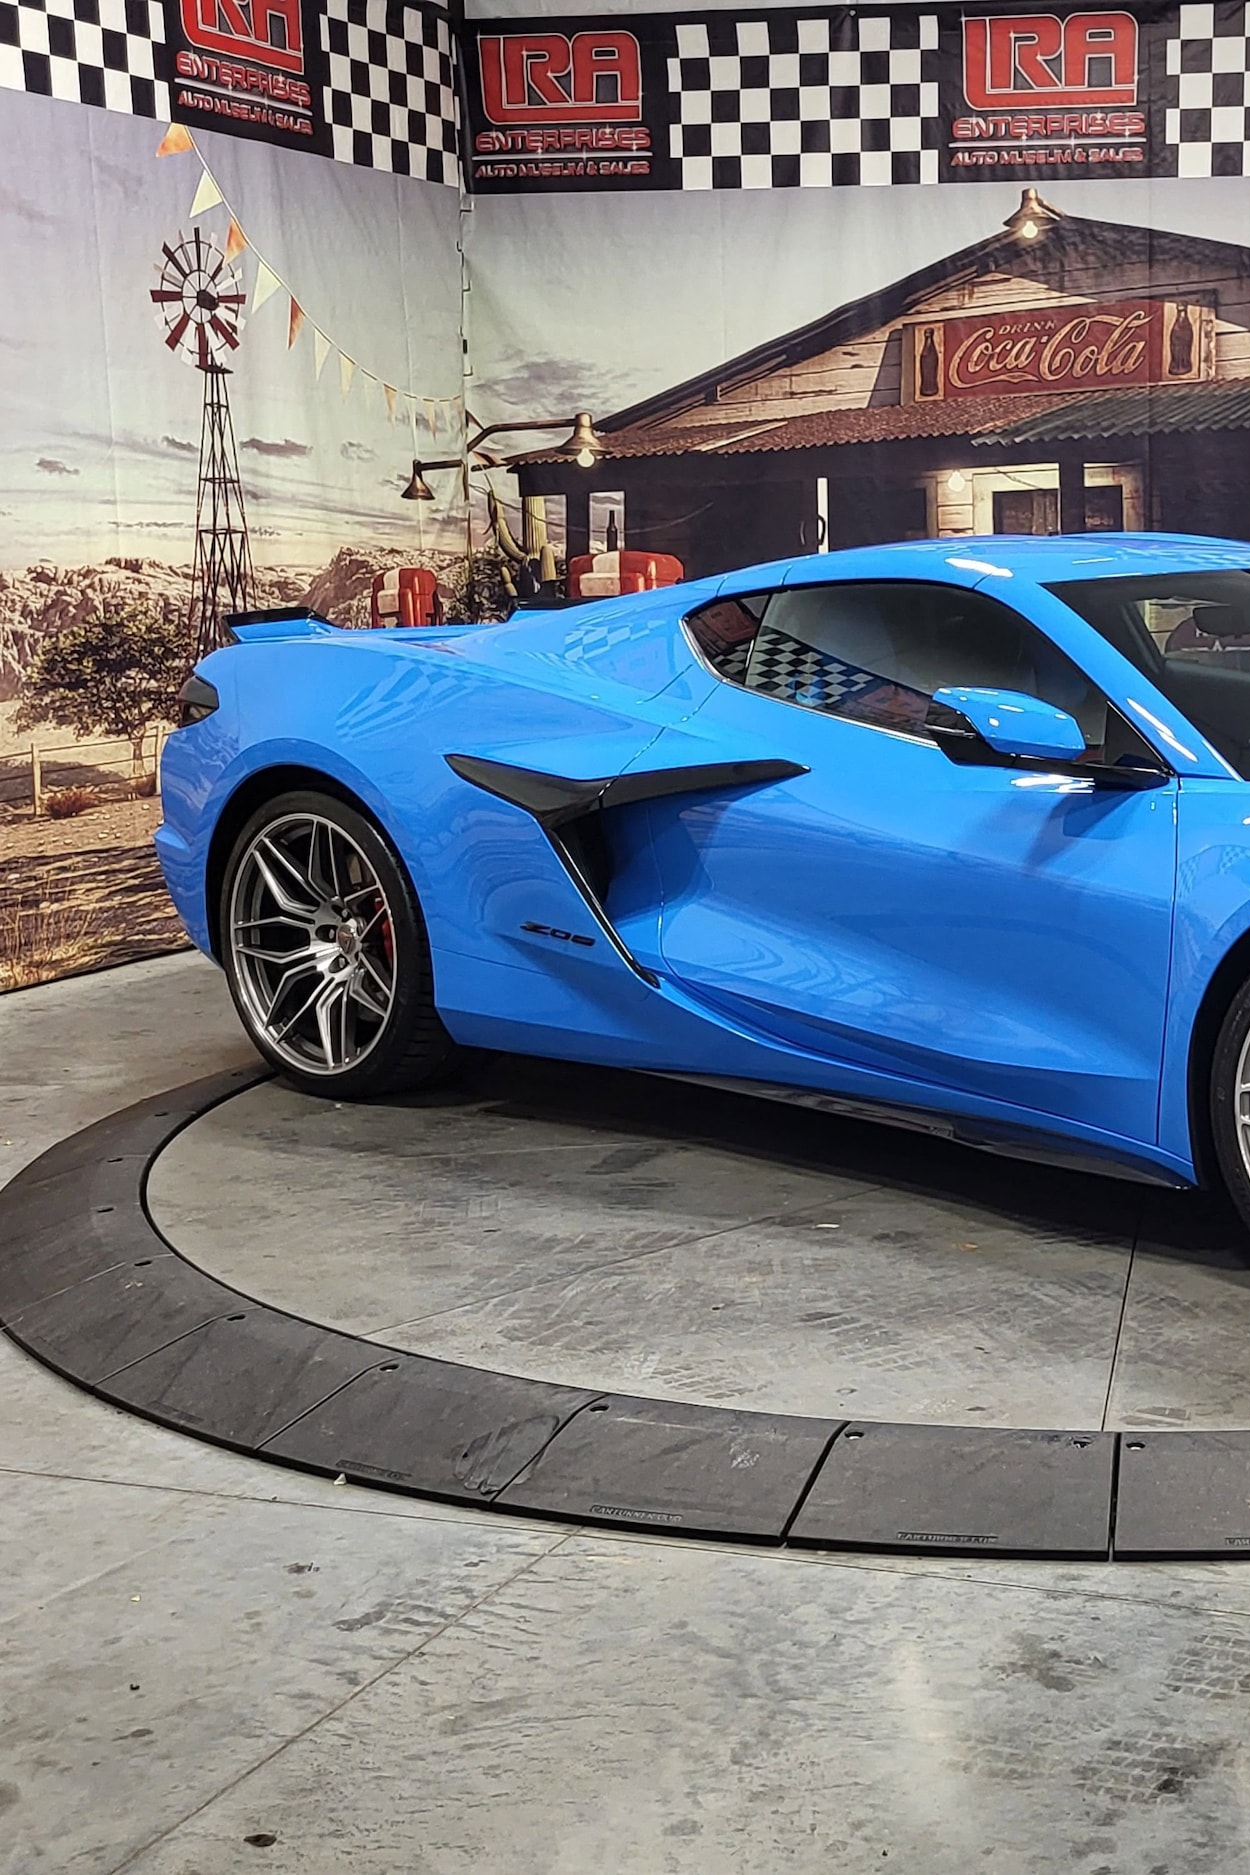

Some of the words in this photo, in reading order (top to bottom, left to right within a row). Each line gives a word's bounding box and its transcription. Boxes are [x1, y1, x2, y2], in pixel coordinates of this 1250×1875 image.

[961, 10, 1138, 110] LRA
[176, 51, 311, 106] ENTERPRISES
[477, 30, 642, 125] LRA
[952, 112, 1146, 138] ENTERPRISES
[475, 127, 651, 151] ENTERPRISES
[951, 151, 997, 166] AUTO
[1000, 149, 1072, 165] MUSEUM
[1088, 147, 1144, 163] SALES
[475, 164, 517, 178] AUTO
[518, 162, 584, 177] MUSEUM
[599, 161, 650, 175] SALES
[998, 320, 1057, 335] DRINK
